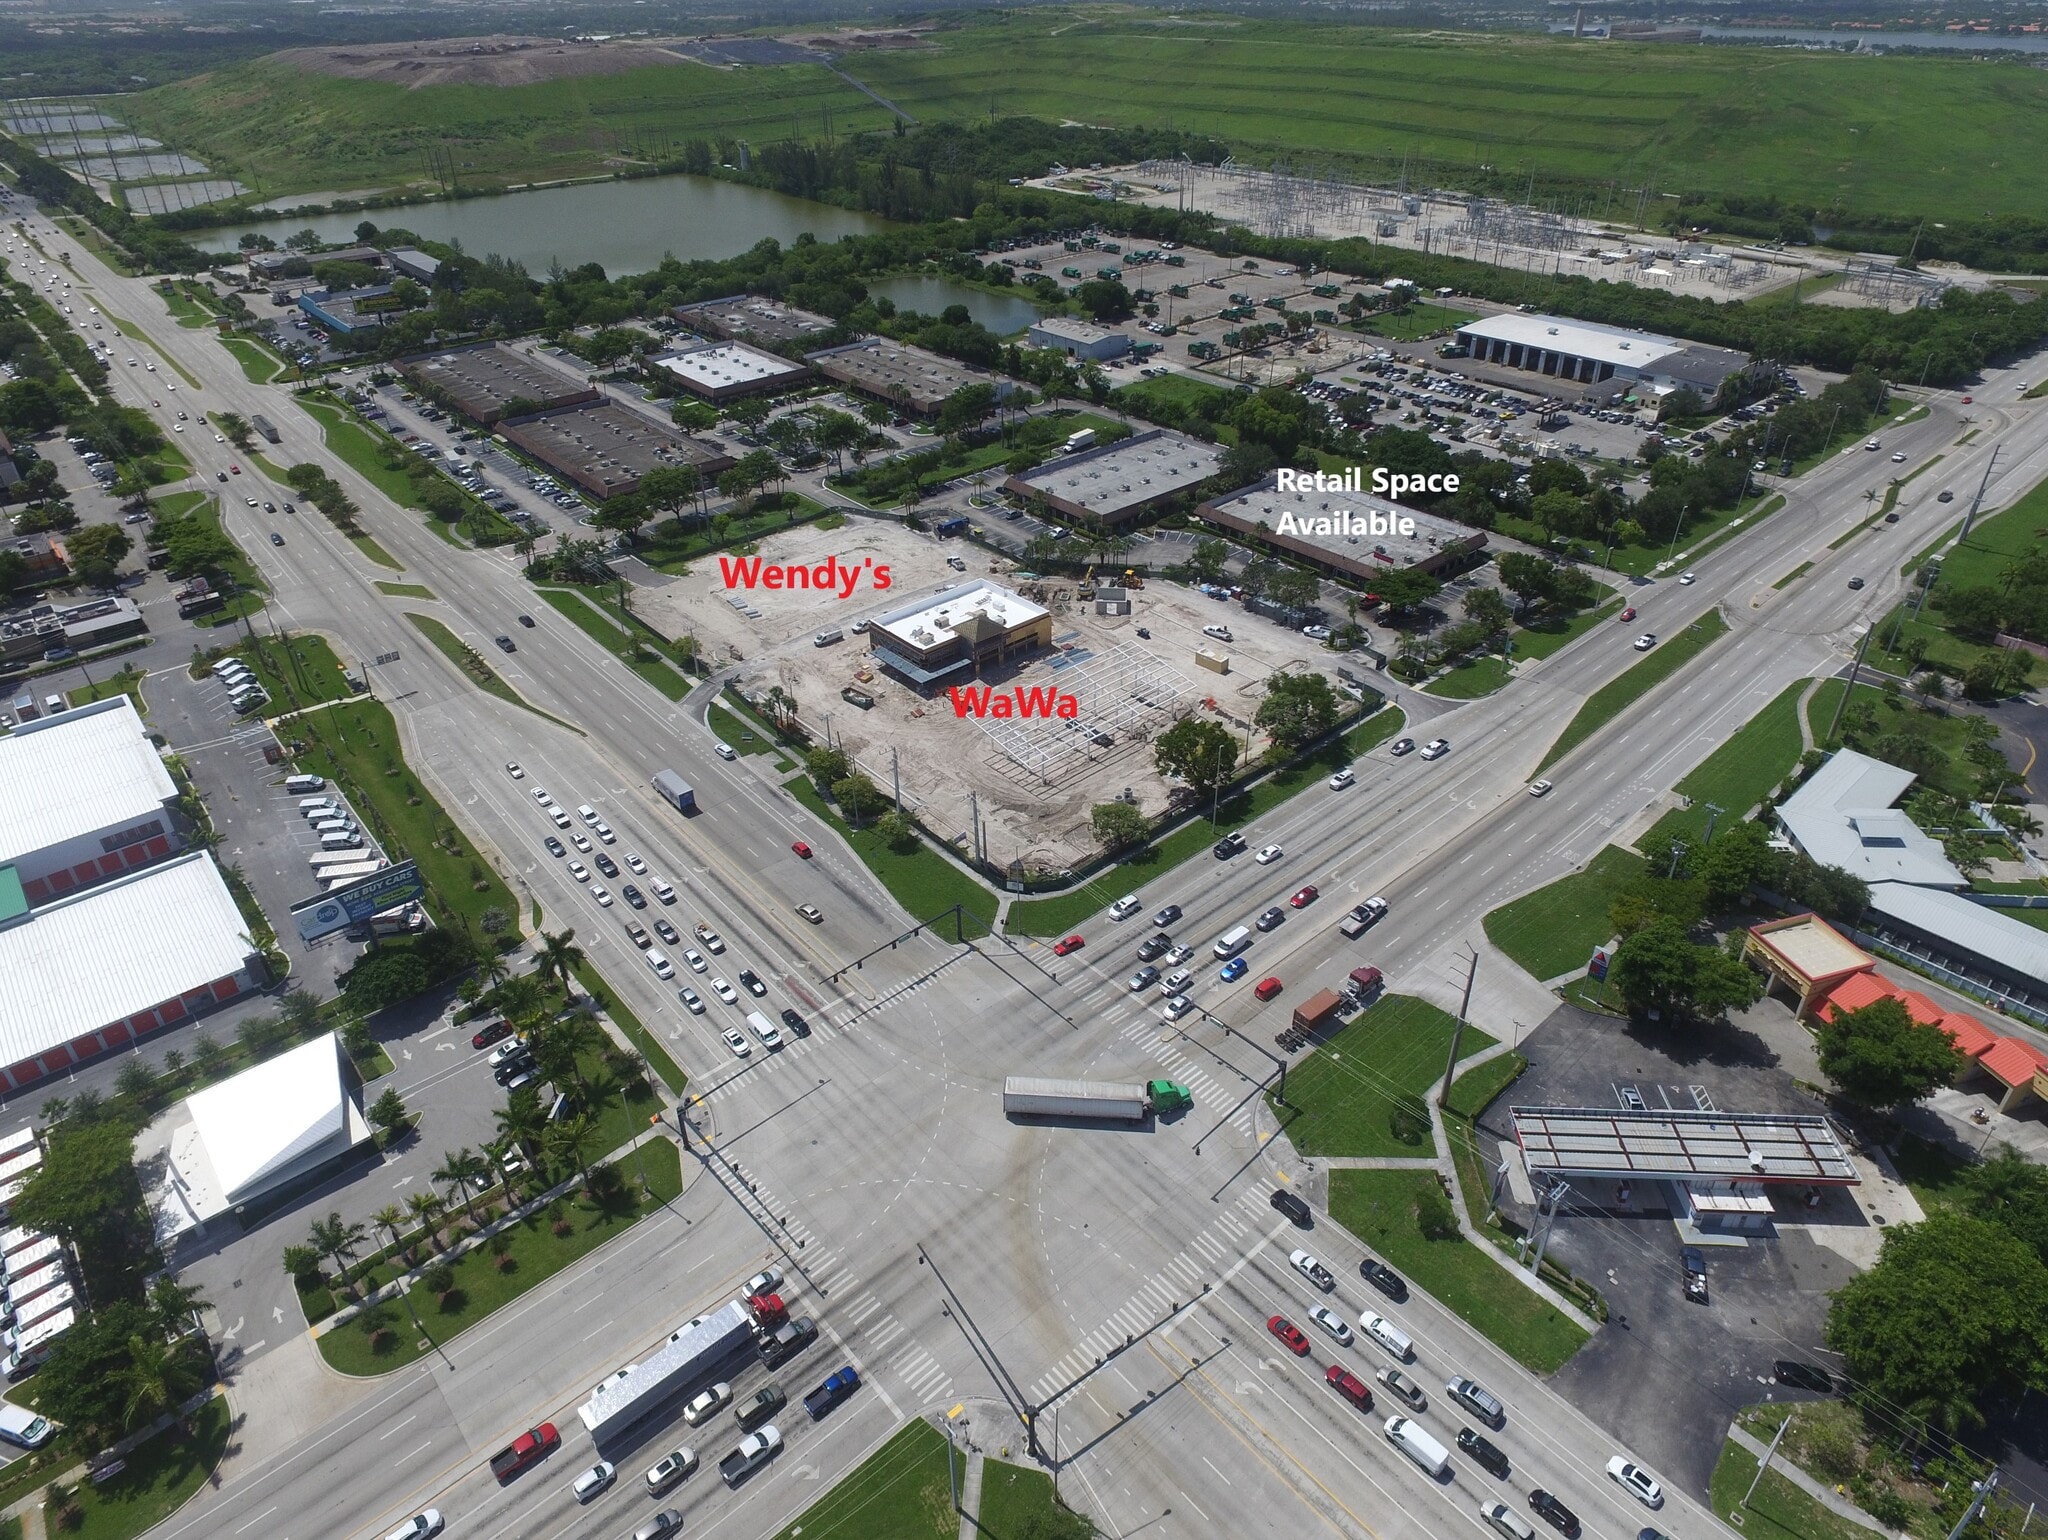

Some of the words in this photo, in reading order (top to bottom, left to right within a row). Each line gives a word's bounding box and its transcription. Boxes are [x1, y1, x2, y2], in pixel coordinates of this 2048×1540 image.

[342, 891, 360, 902] WE
[362, 881, 383, 895] BUY
[385, 871, 412, 885] CARS
